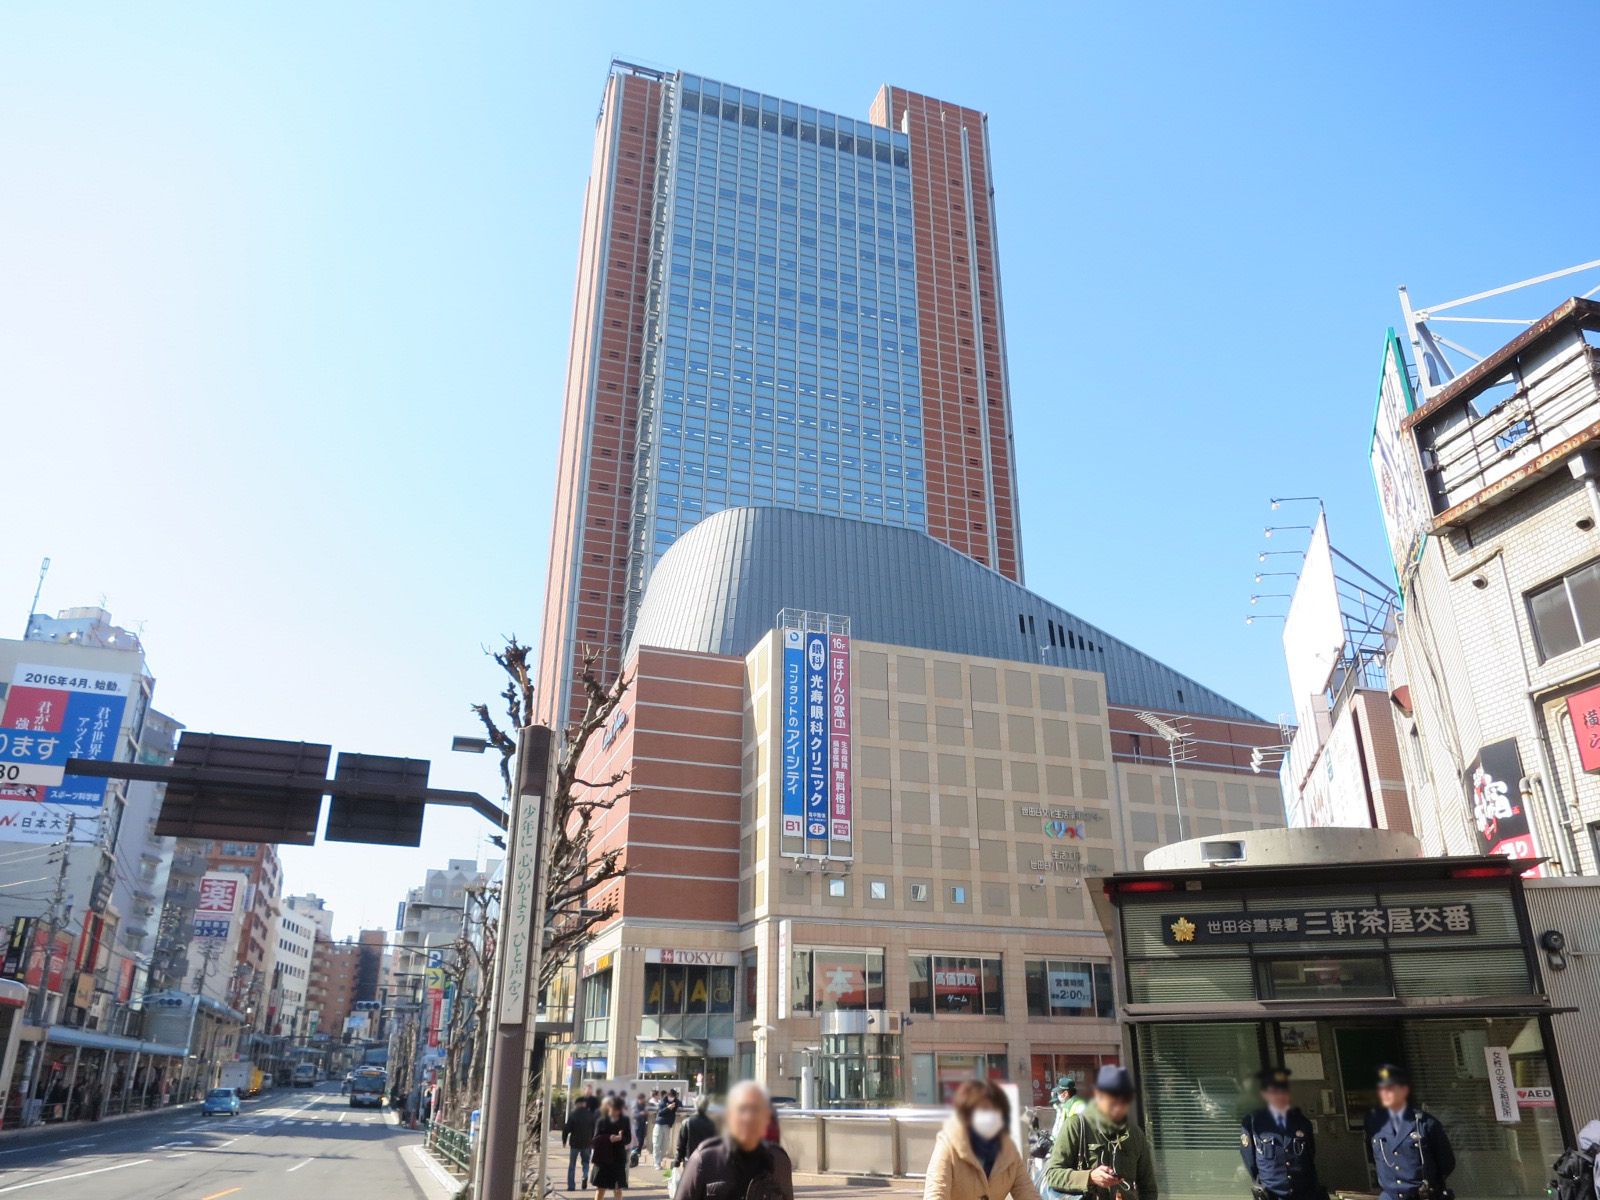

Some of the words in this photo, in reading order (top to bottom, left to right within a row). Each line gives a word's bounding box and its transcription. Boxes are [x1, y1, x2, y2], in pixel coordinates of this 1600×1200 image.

[832, 637, 846, 650] 16F
[811, 641, 823, 668] 眼科
[833, 657, 847, 729] ほけんの窓口
[69, 716, 90, 760] アツくす
[786, 663, 801, 796] コンタクトのアイシティ
[810, 674, 824, 807] 光寿眼科クリニック
[22, 816, 66, 830] 日本大
[785, 820, 801, 833] B1
[811, 824, 824, 834] 2F
[200, 880, 235, 911] 薬
[1206, 916, 1299, 935] 世田谷警察署
[1303, 904, 1471, 936] 三軒茶屋交番
[675, 950, 724, 965] TOKYU
[825, 966, 861, 996] 本
[935, 972, 977, 987] 高価買取
[947, 994, 968, 1003] ゲーム
[1527, 1089, 1552, 1098] AED
